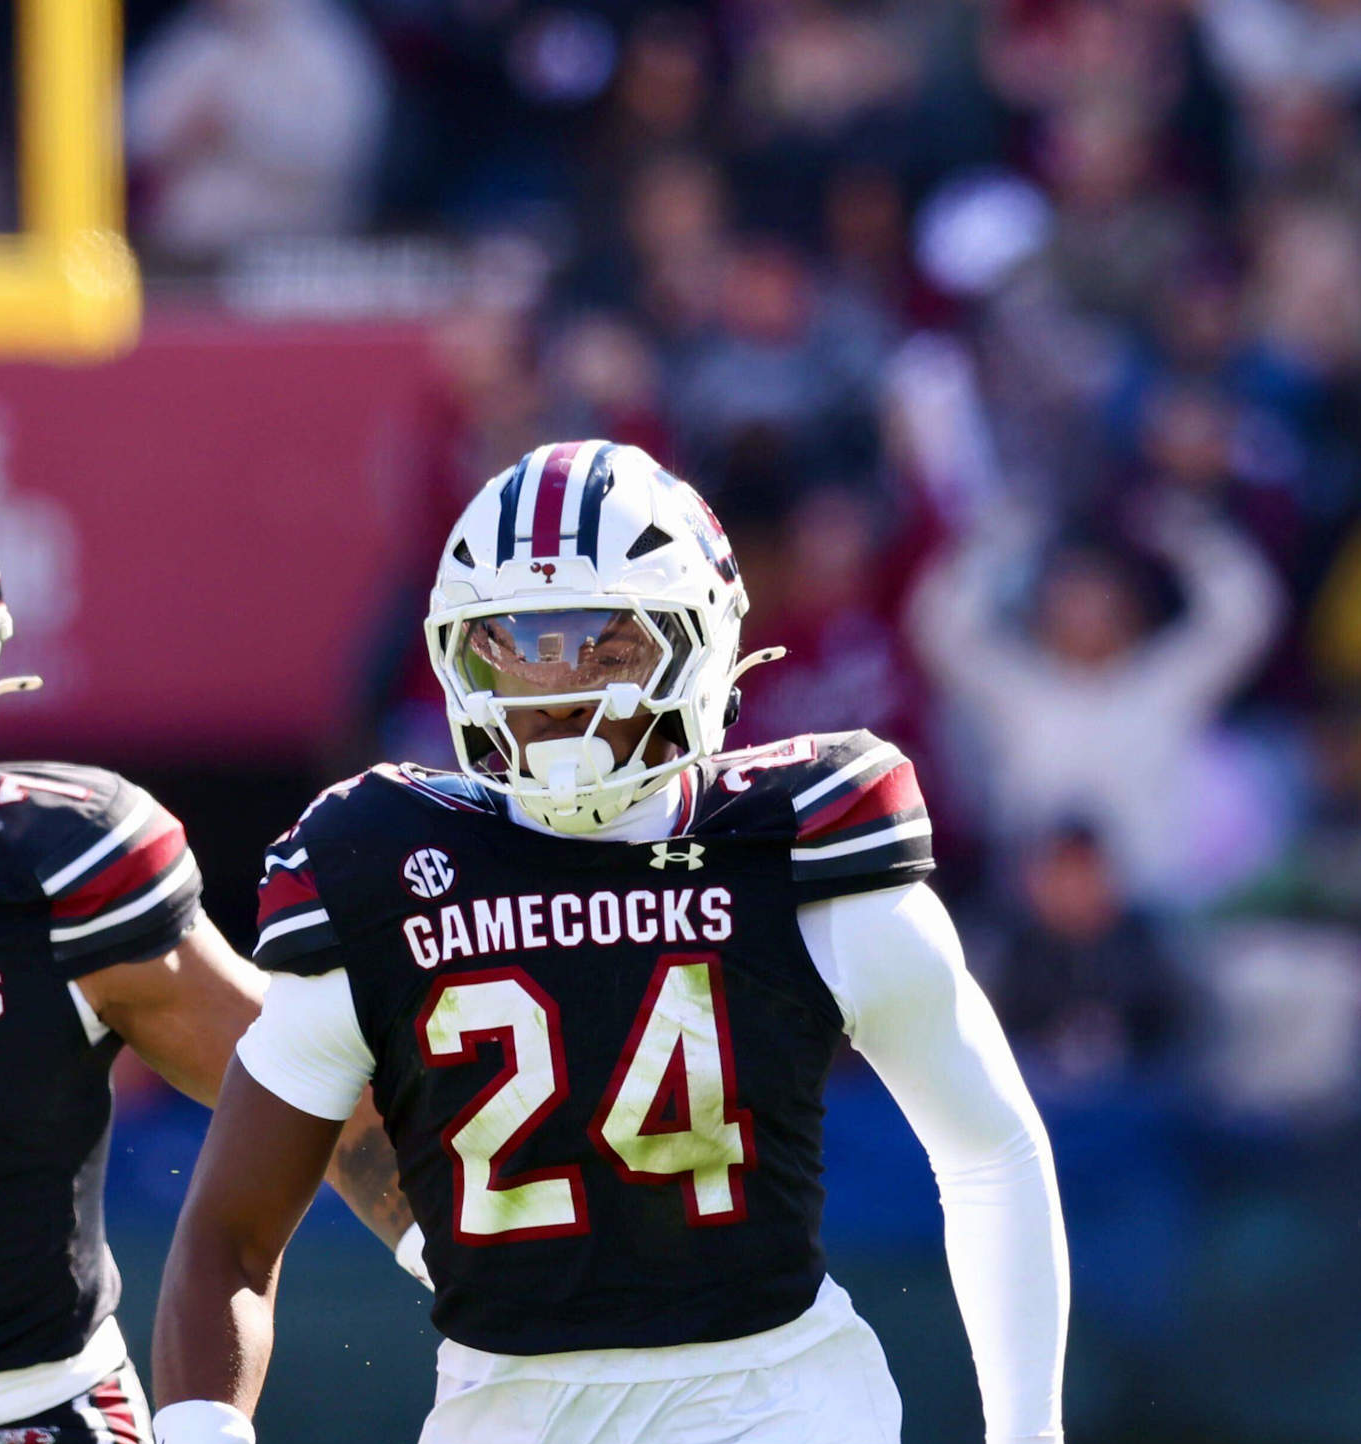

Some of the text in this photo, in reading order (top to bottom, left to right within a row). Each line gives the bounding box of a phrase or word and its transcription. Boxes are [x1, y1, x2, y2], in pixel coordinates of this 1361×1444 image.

[403, 847, 455, 899] SEC
[403, 886, 732, 970] GAMECOCKS
[416, 953, 753, 1245] 24
